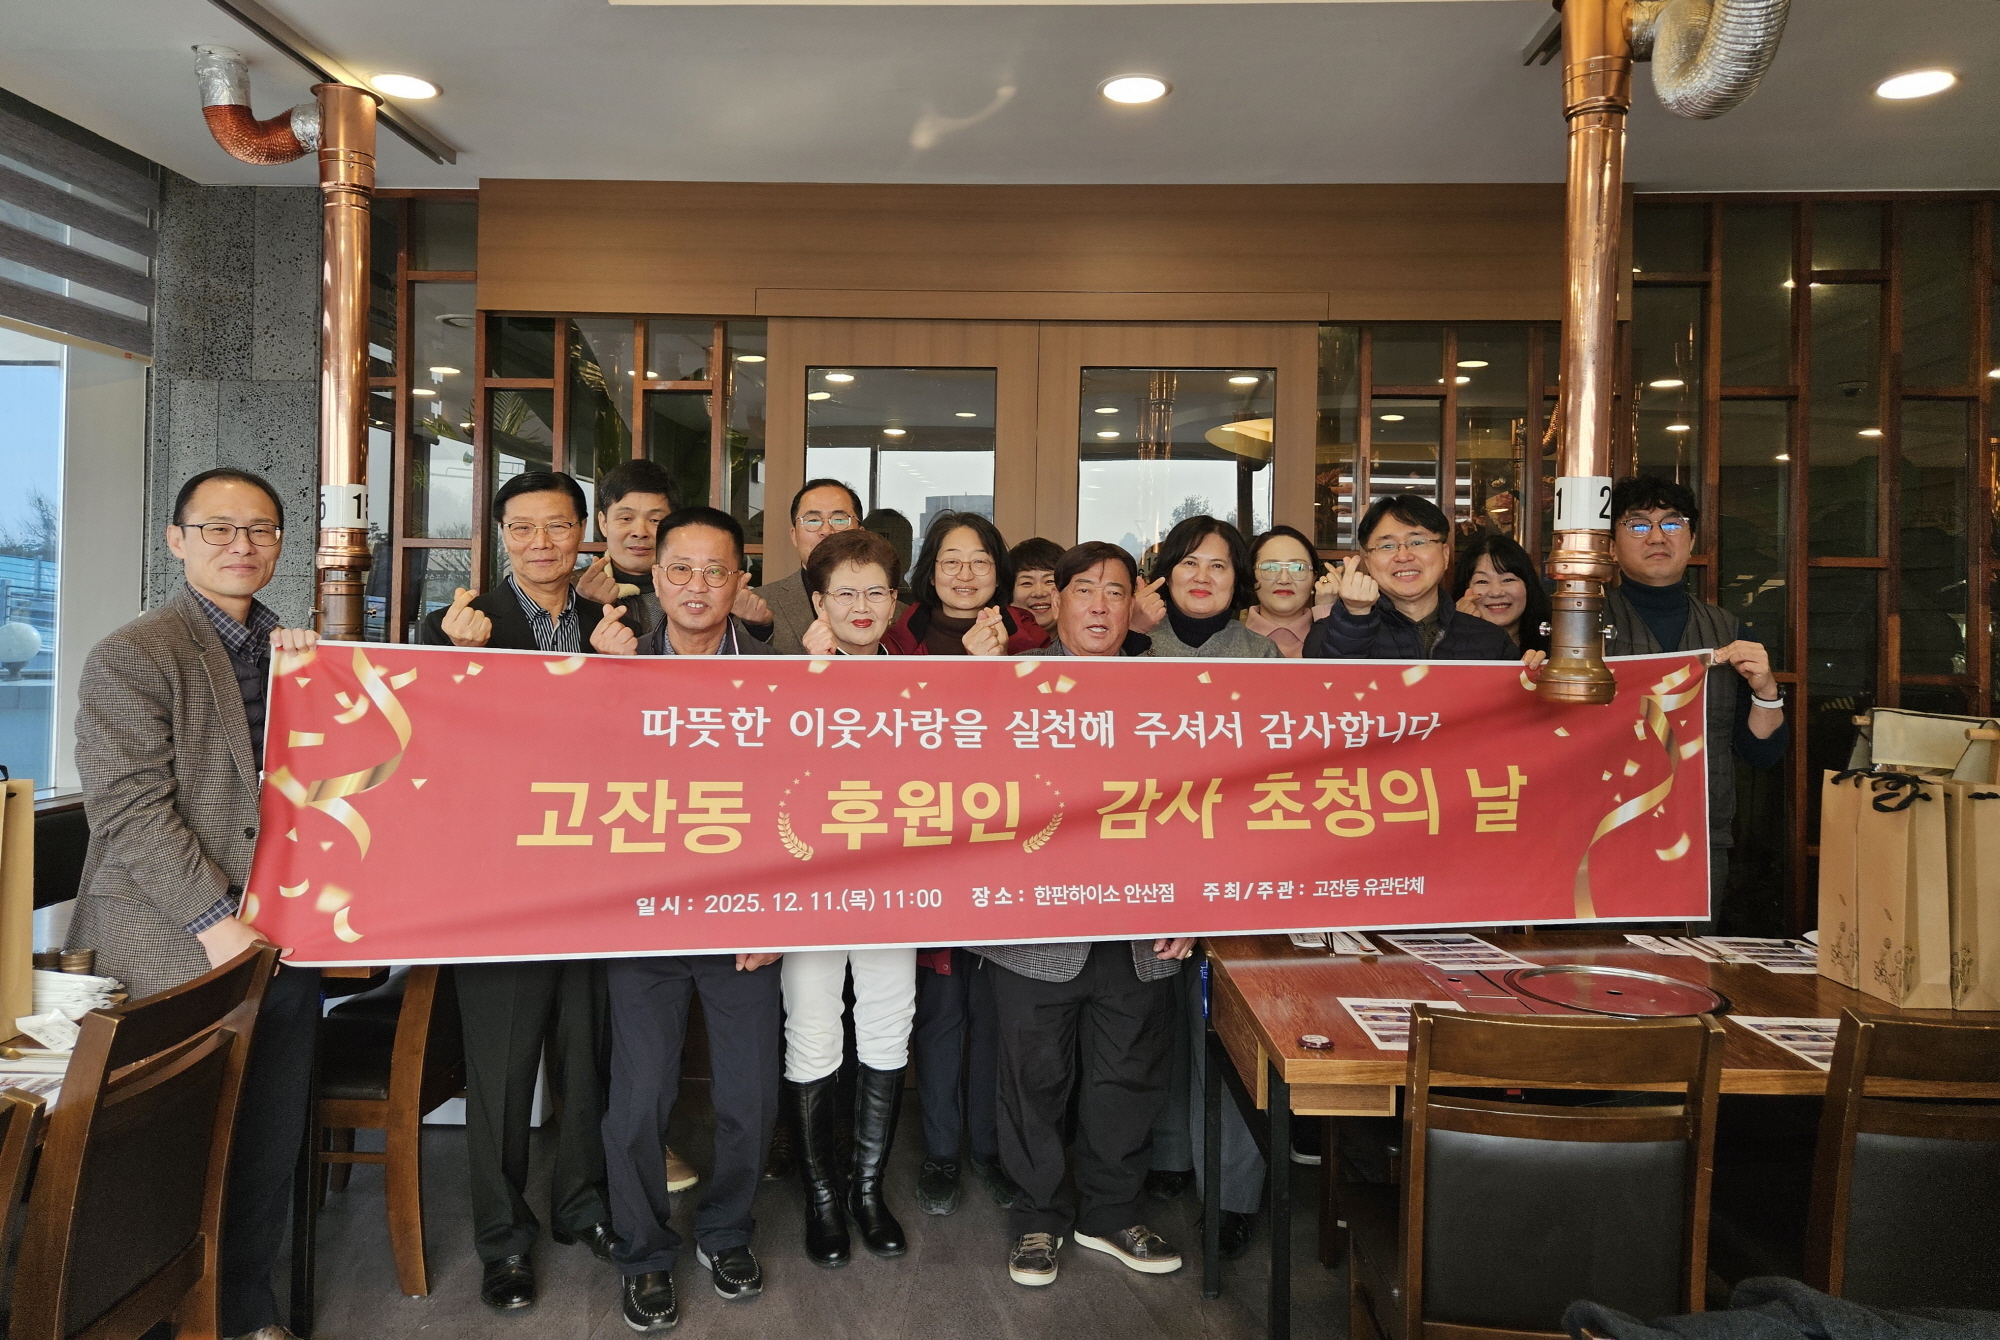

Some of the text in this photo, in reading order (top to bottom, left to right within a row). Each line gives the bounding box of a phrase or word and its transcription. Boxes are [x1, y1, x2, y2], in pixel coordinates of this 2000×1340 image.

[1598, 485, 1612, 520] 2
[640, 705, 1442, 750] 따뜻한 이웃사랑을 실천해 주셔서 감사합니다
[515, 764, 1528, 854] 고잔동 후원인 감사 초청의 날
[704, 893, 766, 914] 2025.
[772, 891, 804, 912] 12.
[882, 888, 943, 909] 11:00
[1033, 883, 1121, 906] 한판하이소
[1123, 882, 1175, 904] 안산점
[1312, 878, 1361, 898] 고잔동
[1362, 875, 1425, 897] 유관단체
